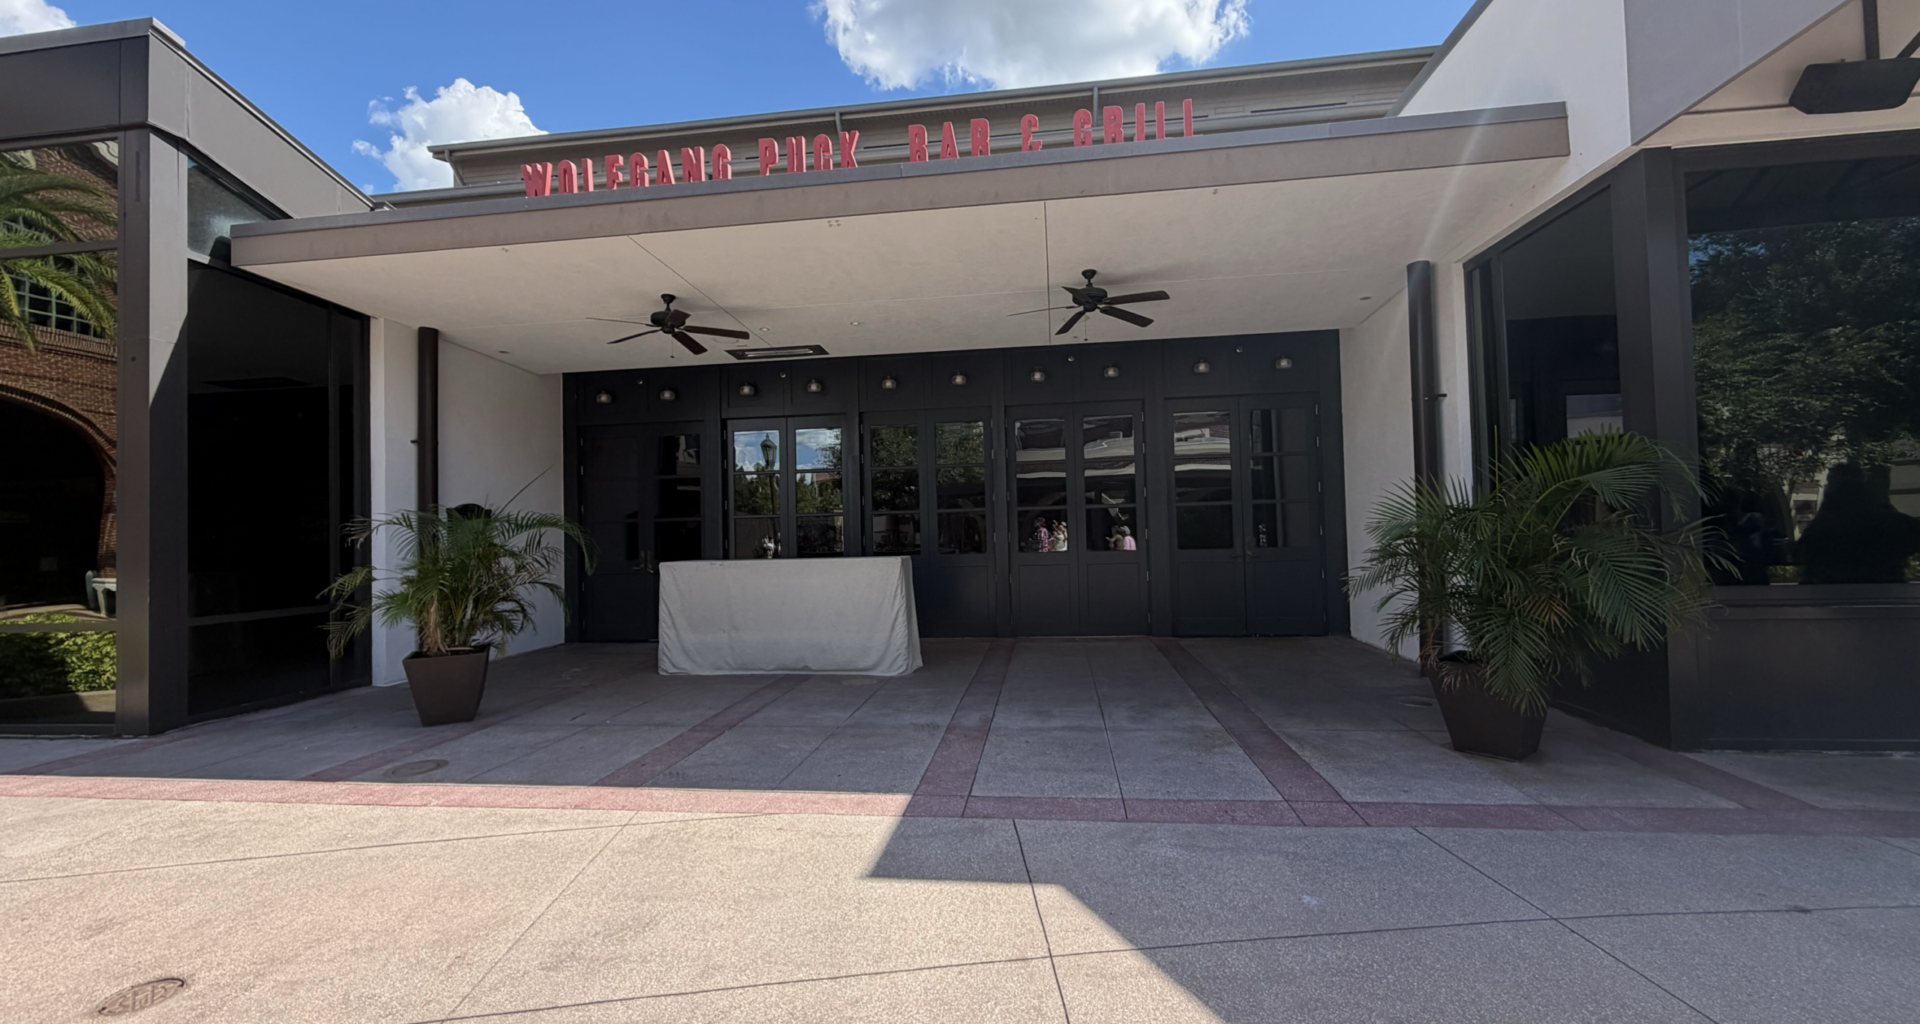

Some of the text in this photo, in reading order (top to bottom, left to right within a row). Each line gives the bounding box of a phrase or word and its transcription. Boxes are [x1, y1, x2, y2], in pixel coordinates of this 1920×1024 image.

[758, 130, 860, 176] PUCK
[908, 118, 990, 162] BAR
[1020, 113, 1043, 152] &
